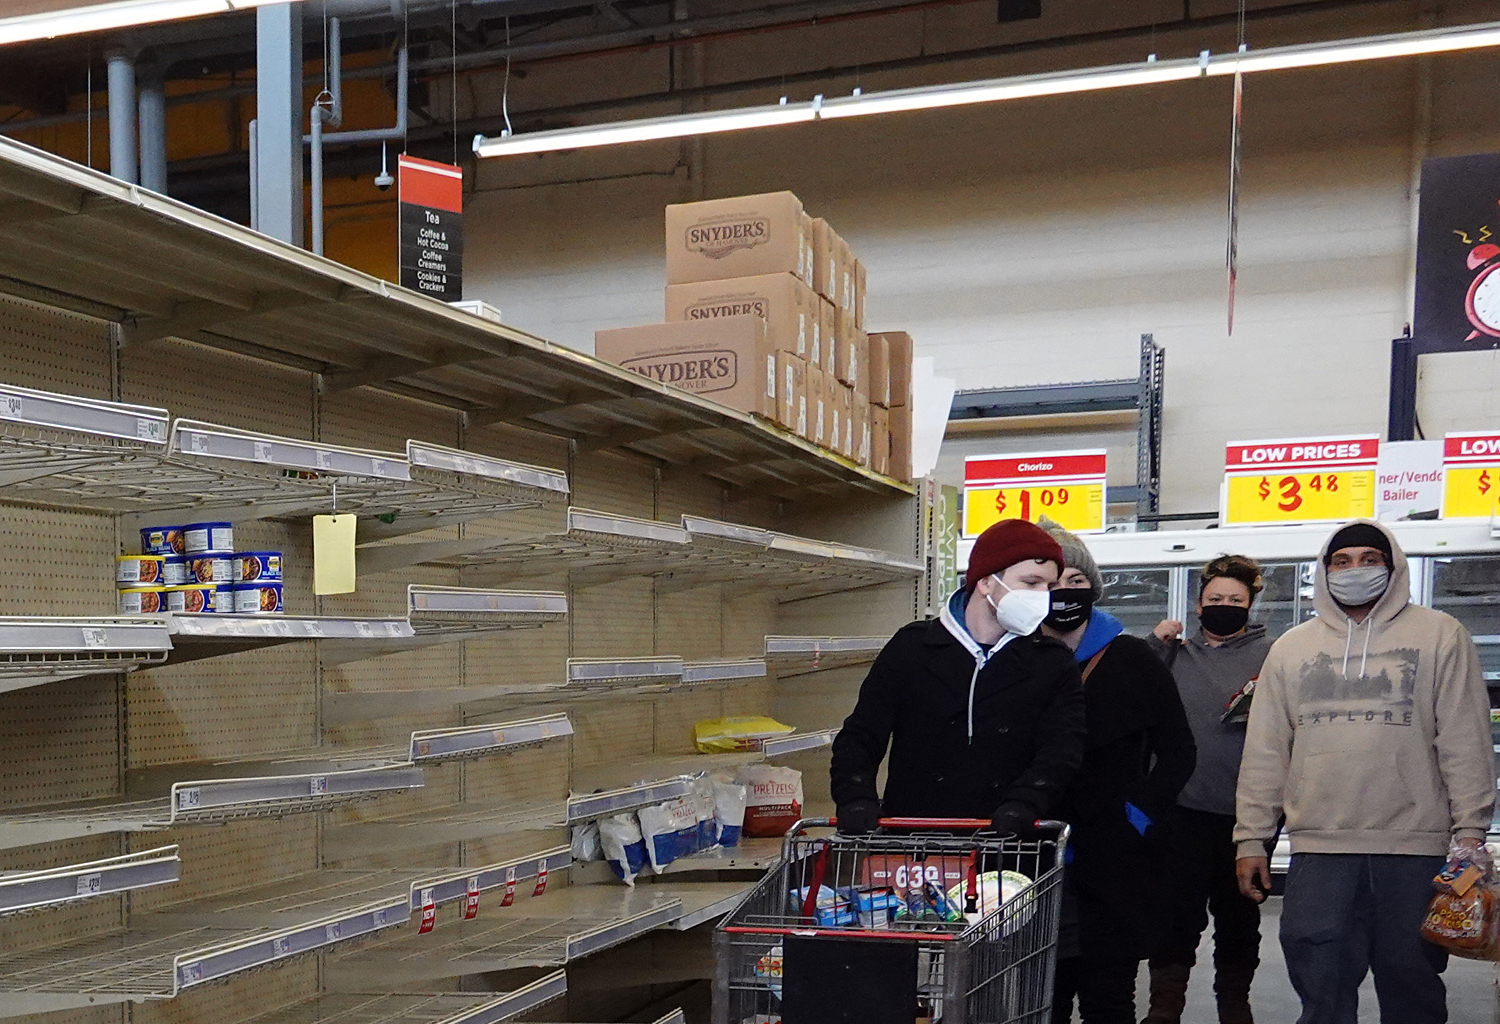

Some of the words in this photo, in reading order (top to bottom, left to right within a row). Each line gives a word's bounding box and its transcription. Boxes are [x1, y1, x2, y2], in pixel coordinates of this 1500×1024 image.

[425, 210, 440, 224] Tea
[420, 228, 440, 240] Coffee
[691, 221, 764, 243] SNYDER'S
[417, 237, 429, 247] Hot
[430, 239, 449, 250] Cocoa
[422, 250, 442, 261] Coffee
[418, 259, 446, 271] Creamers
[417, 271, 441, 282] Cookies
[419, 280, 445, 292] Crackers
[1241, 448, 1287, 463] LOW
[1291, 444, 1361, 460] PRICES
[1460, 440, 1500, 455] LOW
[1017, 462, 1053, 472] Chorizo
[1383, 489, 1418, 501] Bailer
[753, 783, 795, 795] PRETZELS
